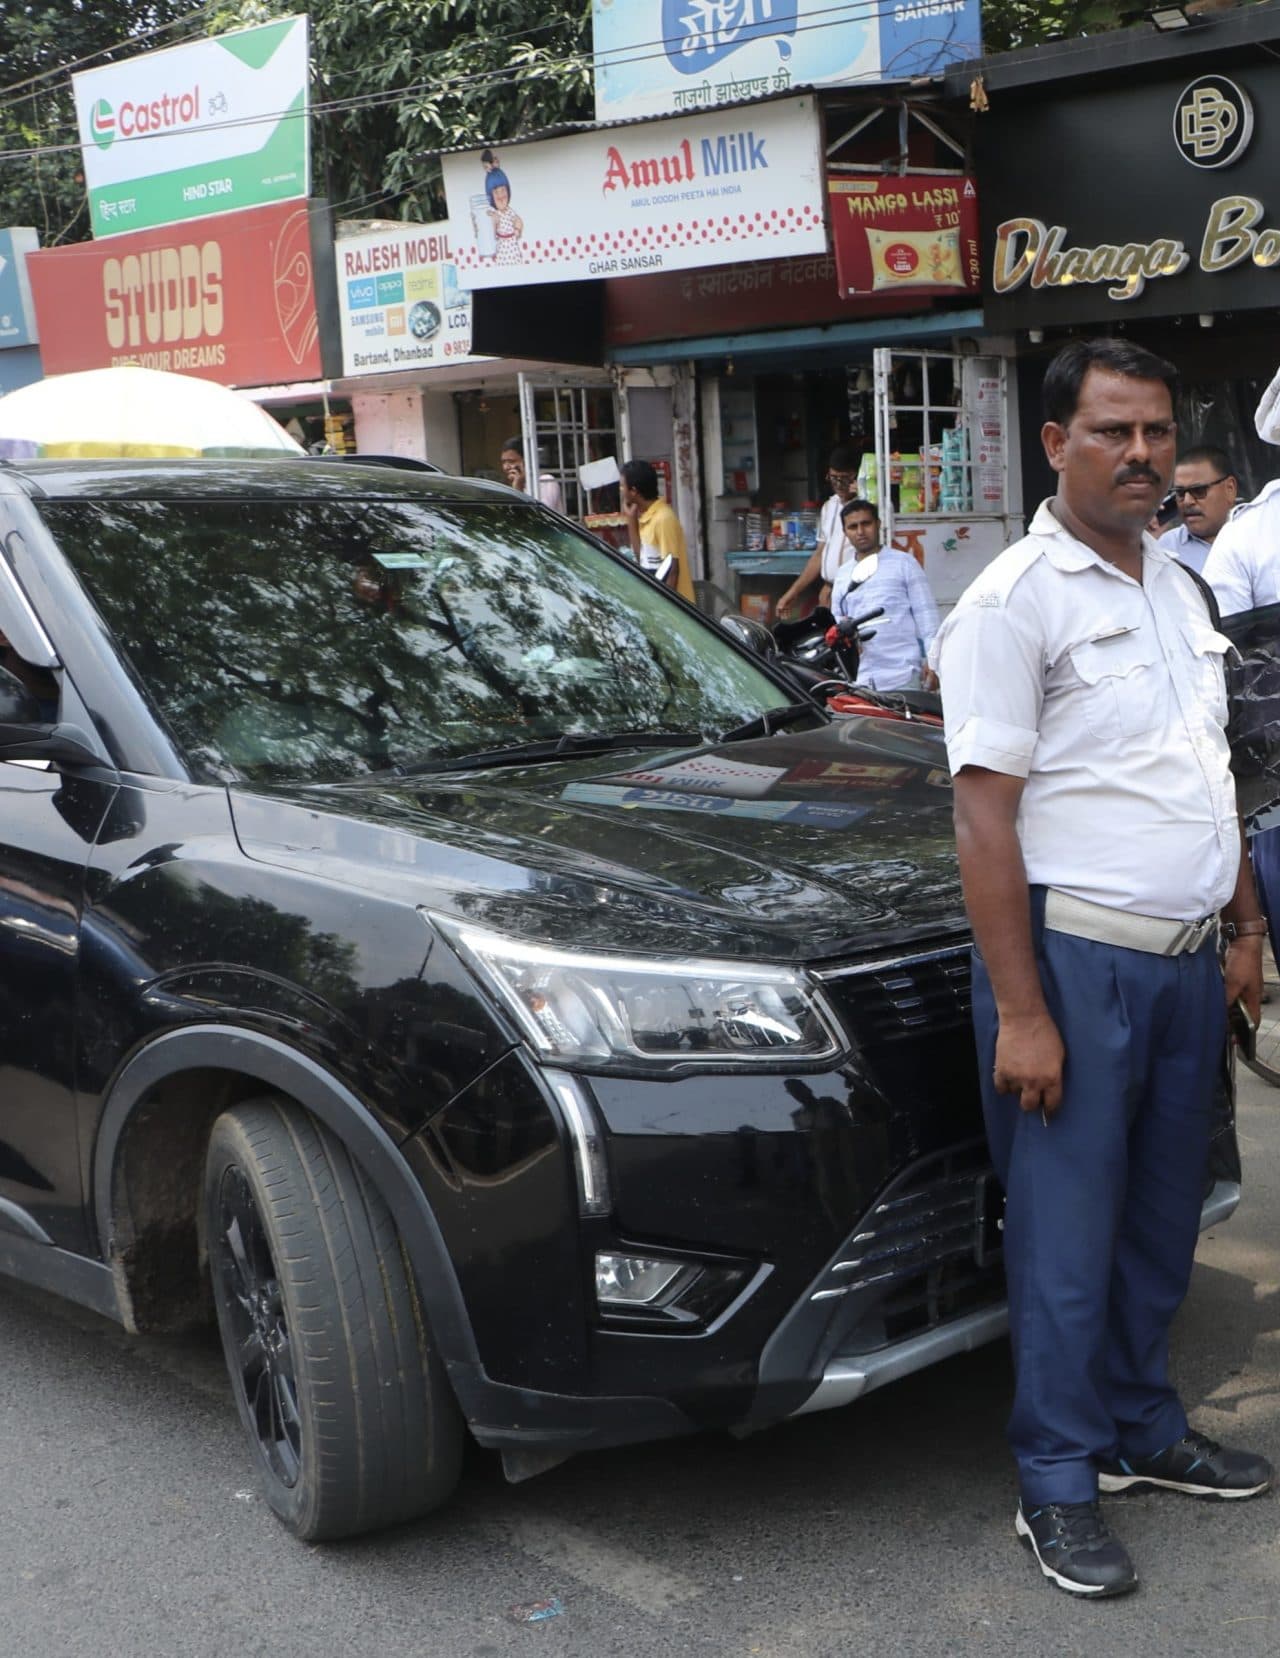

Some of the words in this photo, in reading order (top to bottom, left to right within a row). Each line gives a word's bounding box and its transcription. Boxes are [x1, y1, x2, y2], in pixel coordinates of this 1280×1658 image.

[119, 85, 199, 136] Castrol
[602, 139, 696, 198] Amul
[701, 131, 768, 176] Milk
[183, 183, 207, 200] HIND
[208, 178, 232, 197] STAR
[631, 199, 650, 208] AMUL
[720, 184, 742, 196] INDIA
[847, 193, 908, 222] MANGO
[912, 187, 959, 213] LASSI
[345, 243, 400, 276] RAJESH
[588, 259, 618, 274] GHAR
[621, 254, 663, 271] SANSAR
[994, 218, 1191, 301] Dhaaga
[103, 241, 223, 348] STUDDS
[139, 350, 171, 371] YOUR
[173, 343, 226, 369] DREAMS
[394, 345, 433, 360] Dhanbad
